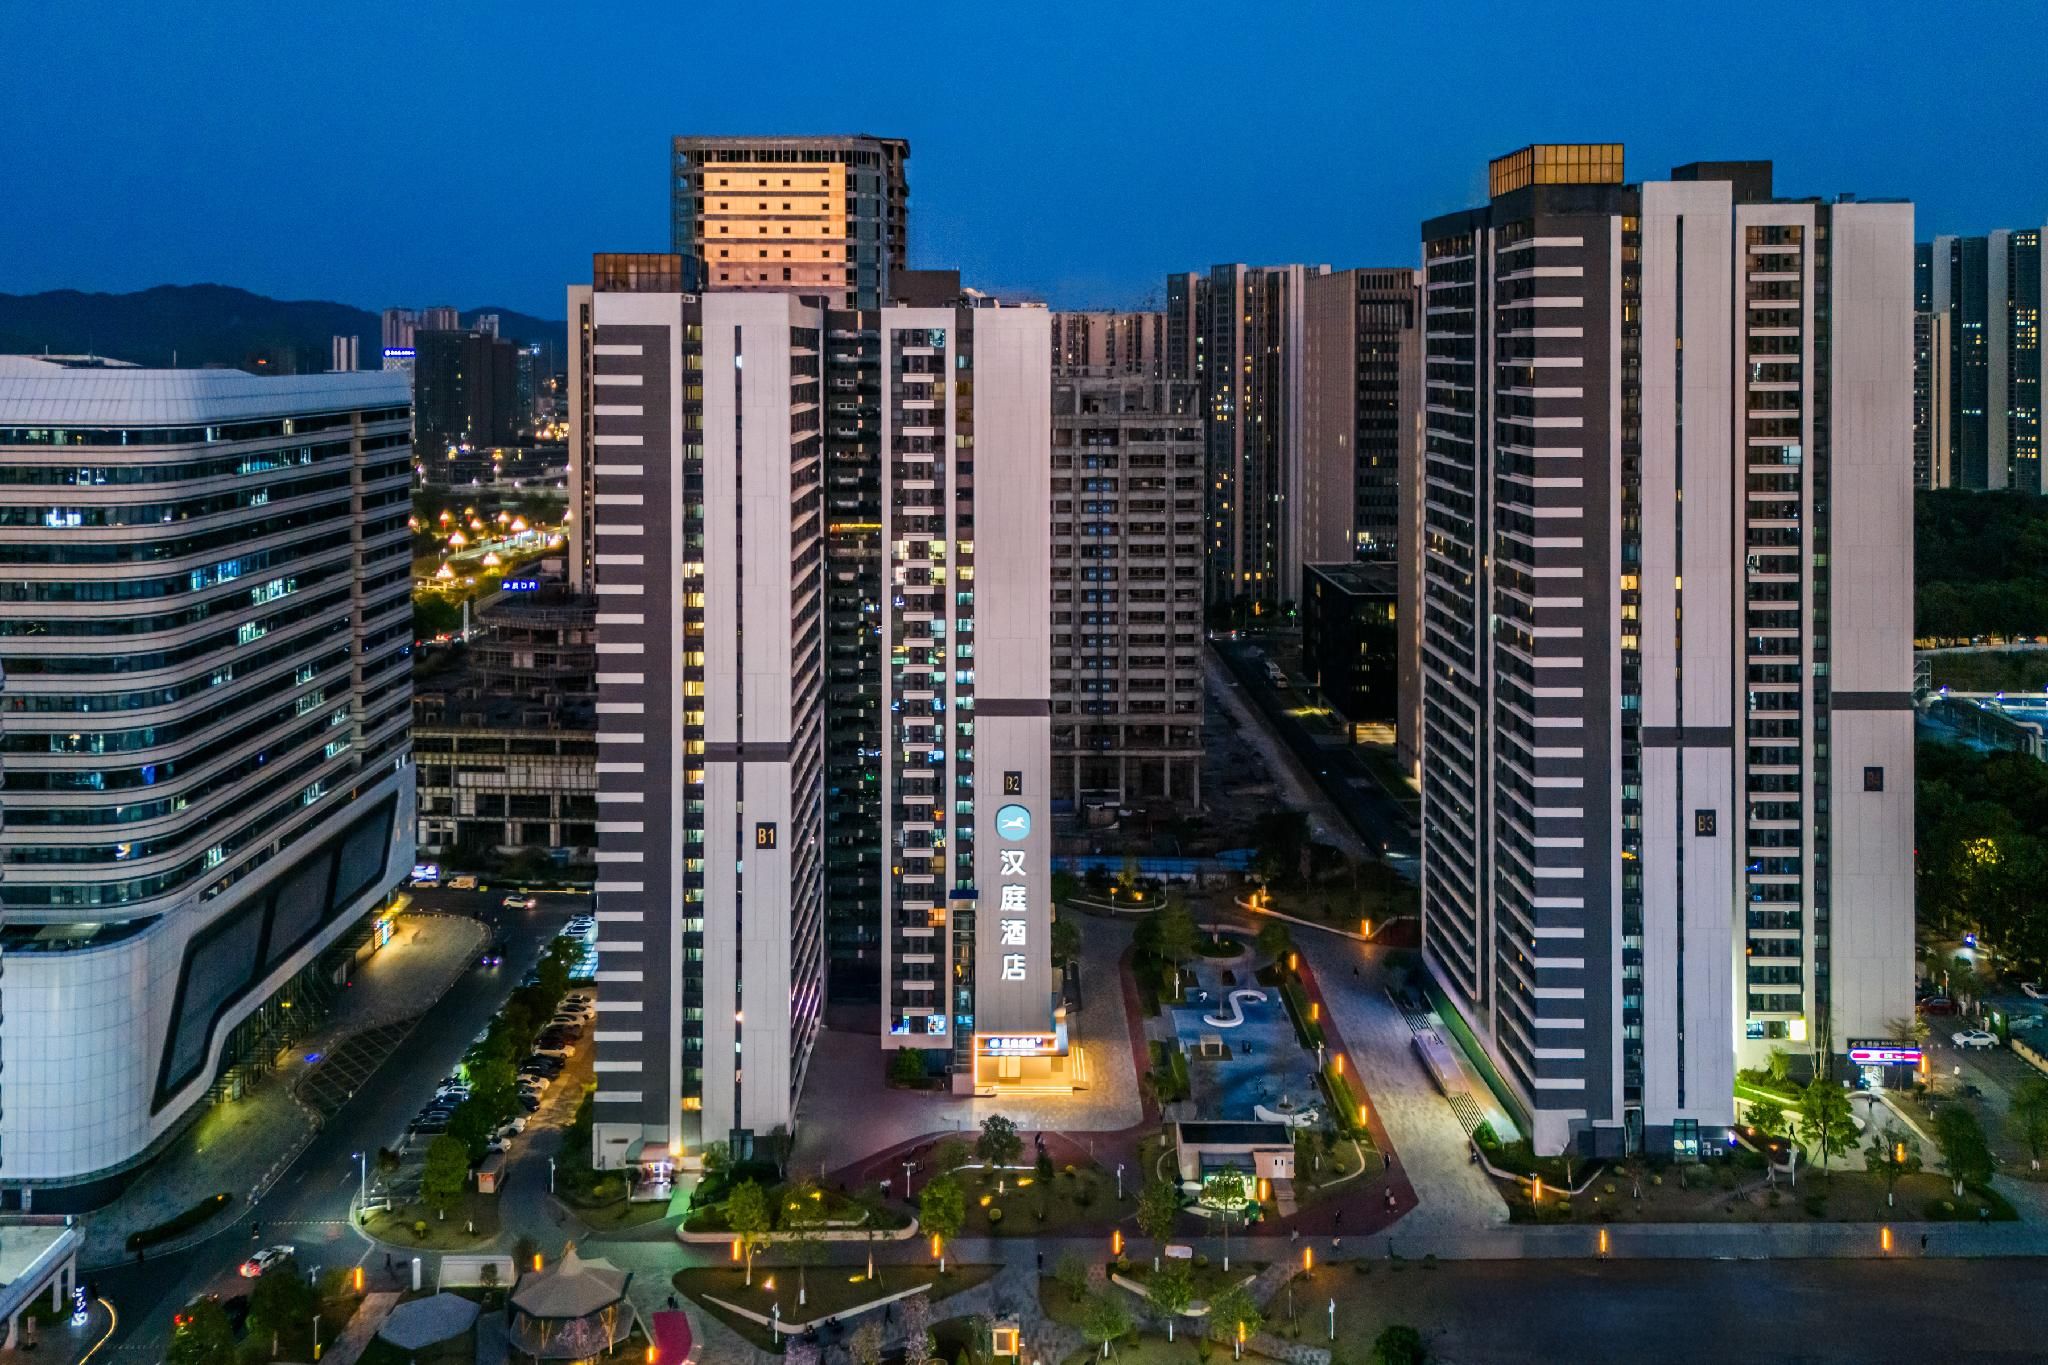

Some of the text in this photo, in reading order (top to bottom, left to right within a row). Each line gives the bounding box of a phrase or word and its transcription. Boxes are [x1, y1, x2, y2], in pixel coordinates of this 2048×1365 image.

[1006, 775, 1020, 791] B2
[1698, 815, 1713, 832] B3
[758, 828, 774, 844] B1
[1000, 849, 1026, 981] 汉庭酒店
